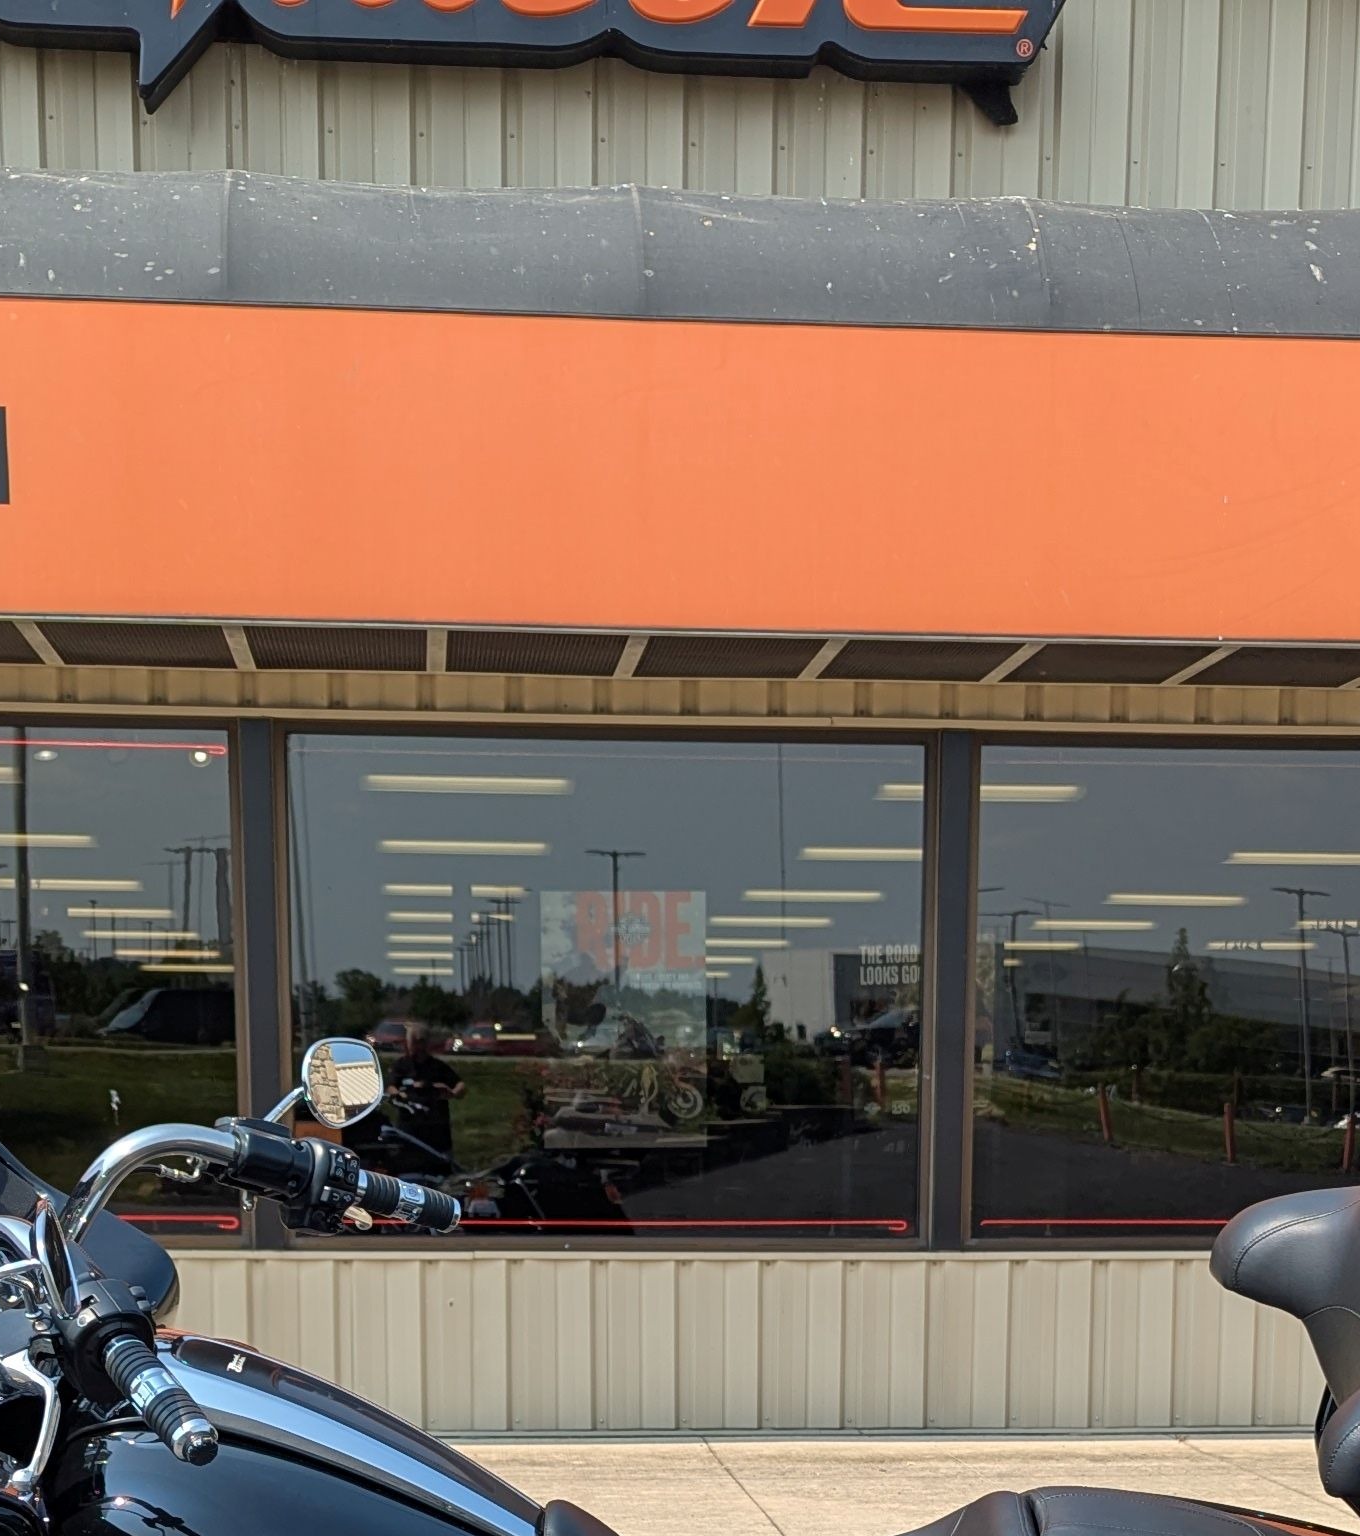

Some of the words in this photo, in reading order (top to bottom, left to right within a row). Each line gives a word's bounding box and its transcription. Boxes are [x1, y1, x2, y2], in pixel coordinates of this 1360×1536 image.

[859, 945, 883, 965] THE
[886, 944, 918, 963] ROAD
[860, 966, 899, 986] LOOKS
[902, 965, 920, 985] GO
